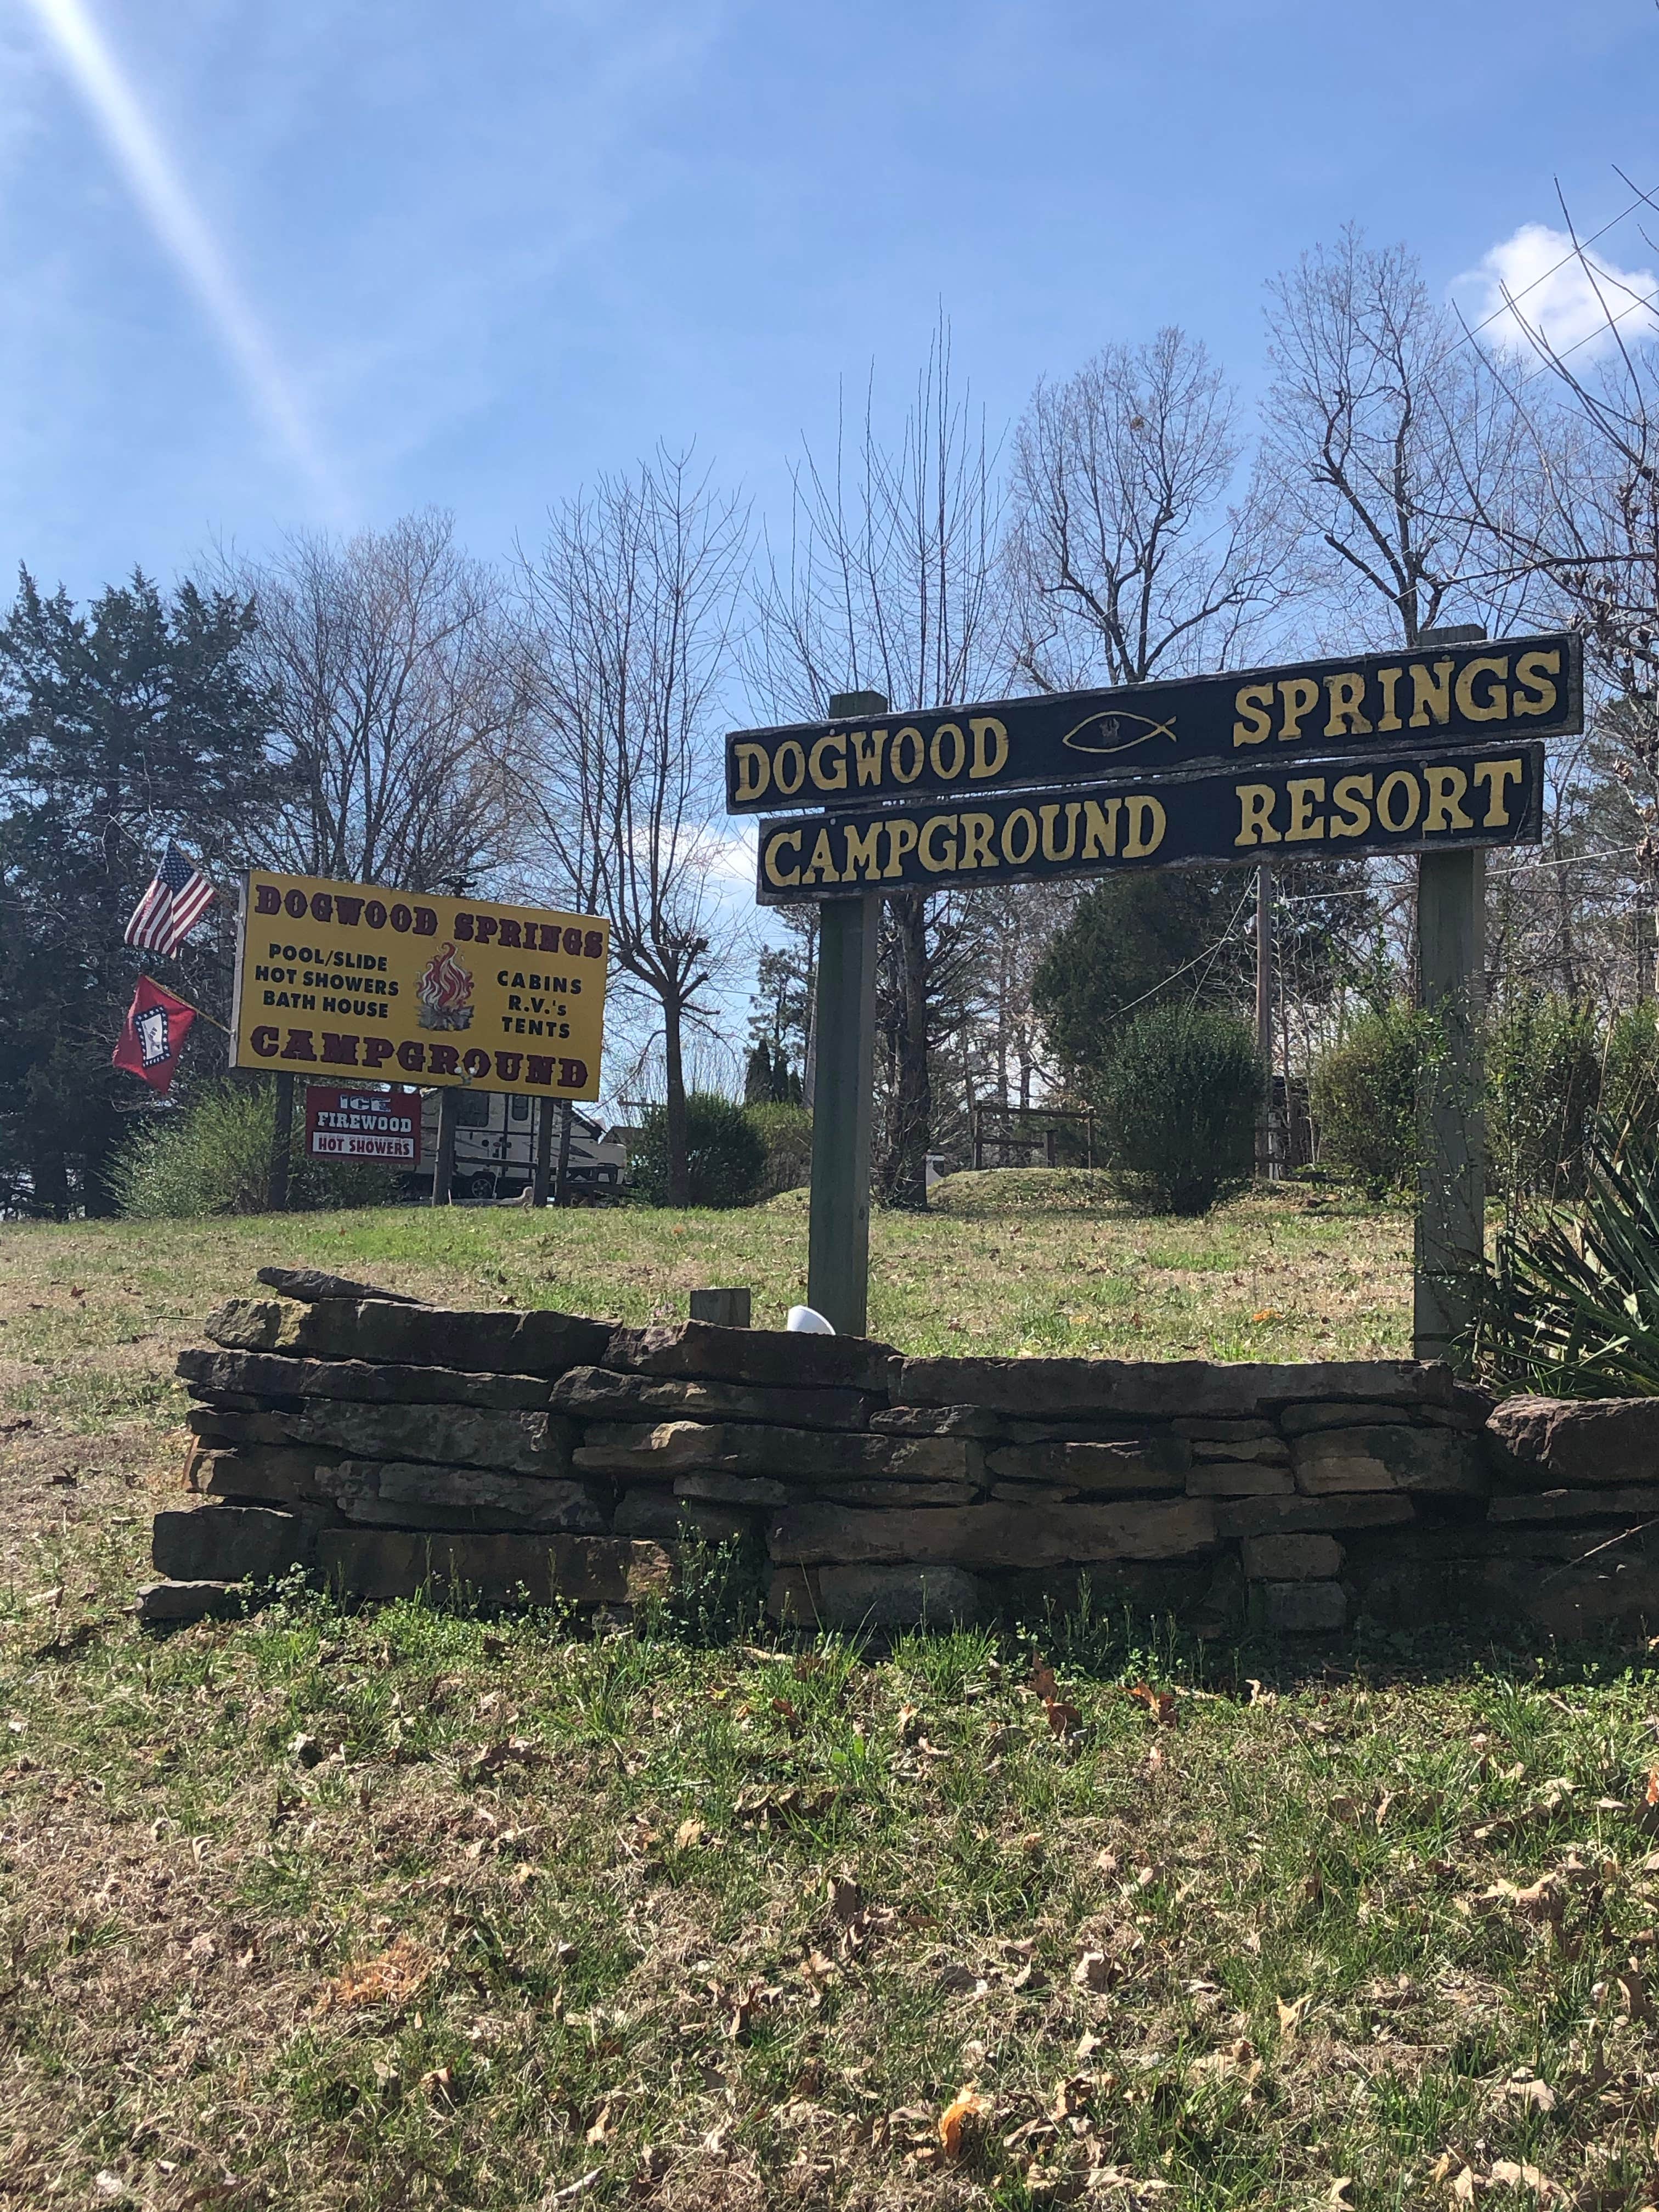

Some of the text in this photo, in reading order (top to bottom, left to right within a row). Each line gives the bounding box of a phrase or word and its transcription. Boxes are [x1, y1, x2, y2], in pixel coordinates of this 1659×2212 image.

[734, 649, 1560, 802] DOGWOOD SPRINGS
[765, 758, 1522, 887] CAMPGROUND RESORT
[254, 884, 603, 958] DOGWOOD SPRINGS
[269, 943, 387, 972] POOL/SLIDE
[255, 965, 398, 996] HOT SHOWERS
[497, 970, 582, 994] CABINS
[263, 990, 388, 1018] BATH HOUSE
[501, 1016, 569, 1039] TENTS
[250, 1025, 588, 1088] CAMPGROUND
[340, 1094, 391, 1112] ICE
[318, 1111, 411, 1132] FIREWOOD
[318, 1137, 409, 1155] HOT SHOWERS
